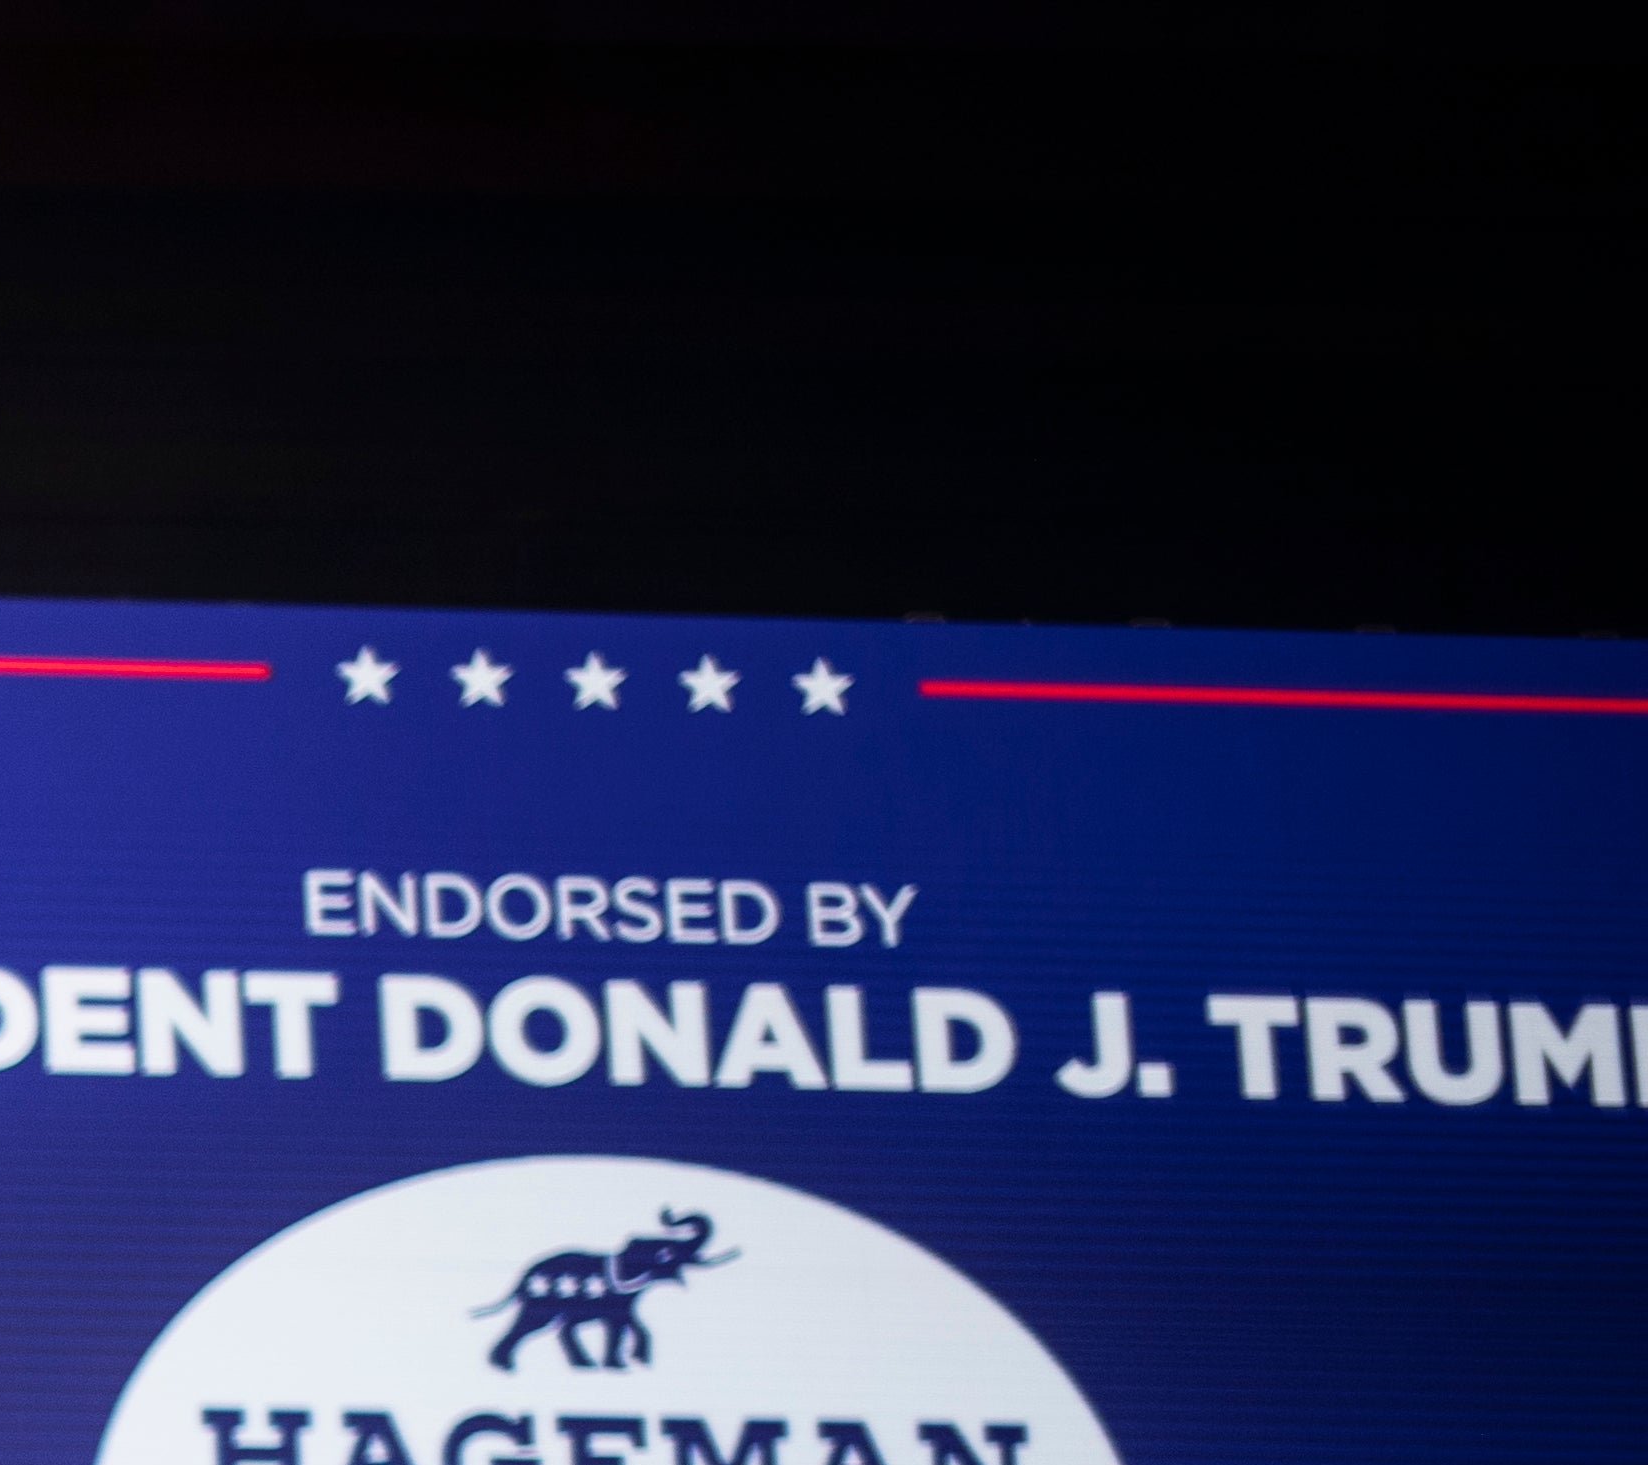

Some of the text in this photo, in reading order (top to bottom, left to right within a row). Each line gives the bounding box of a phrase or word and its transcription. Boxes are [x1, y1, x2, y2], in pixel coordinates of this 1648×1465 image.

[303, 868, 918, 948] ENDORSED BY
[378, 972, 1018, 1095] DONALD
[1056, 992, 1175, 1098] J.
